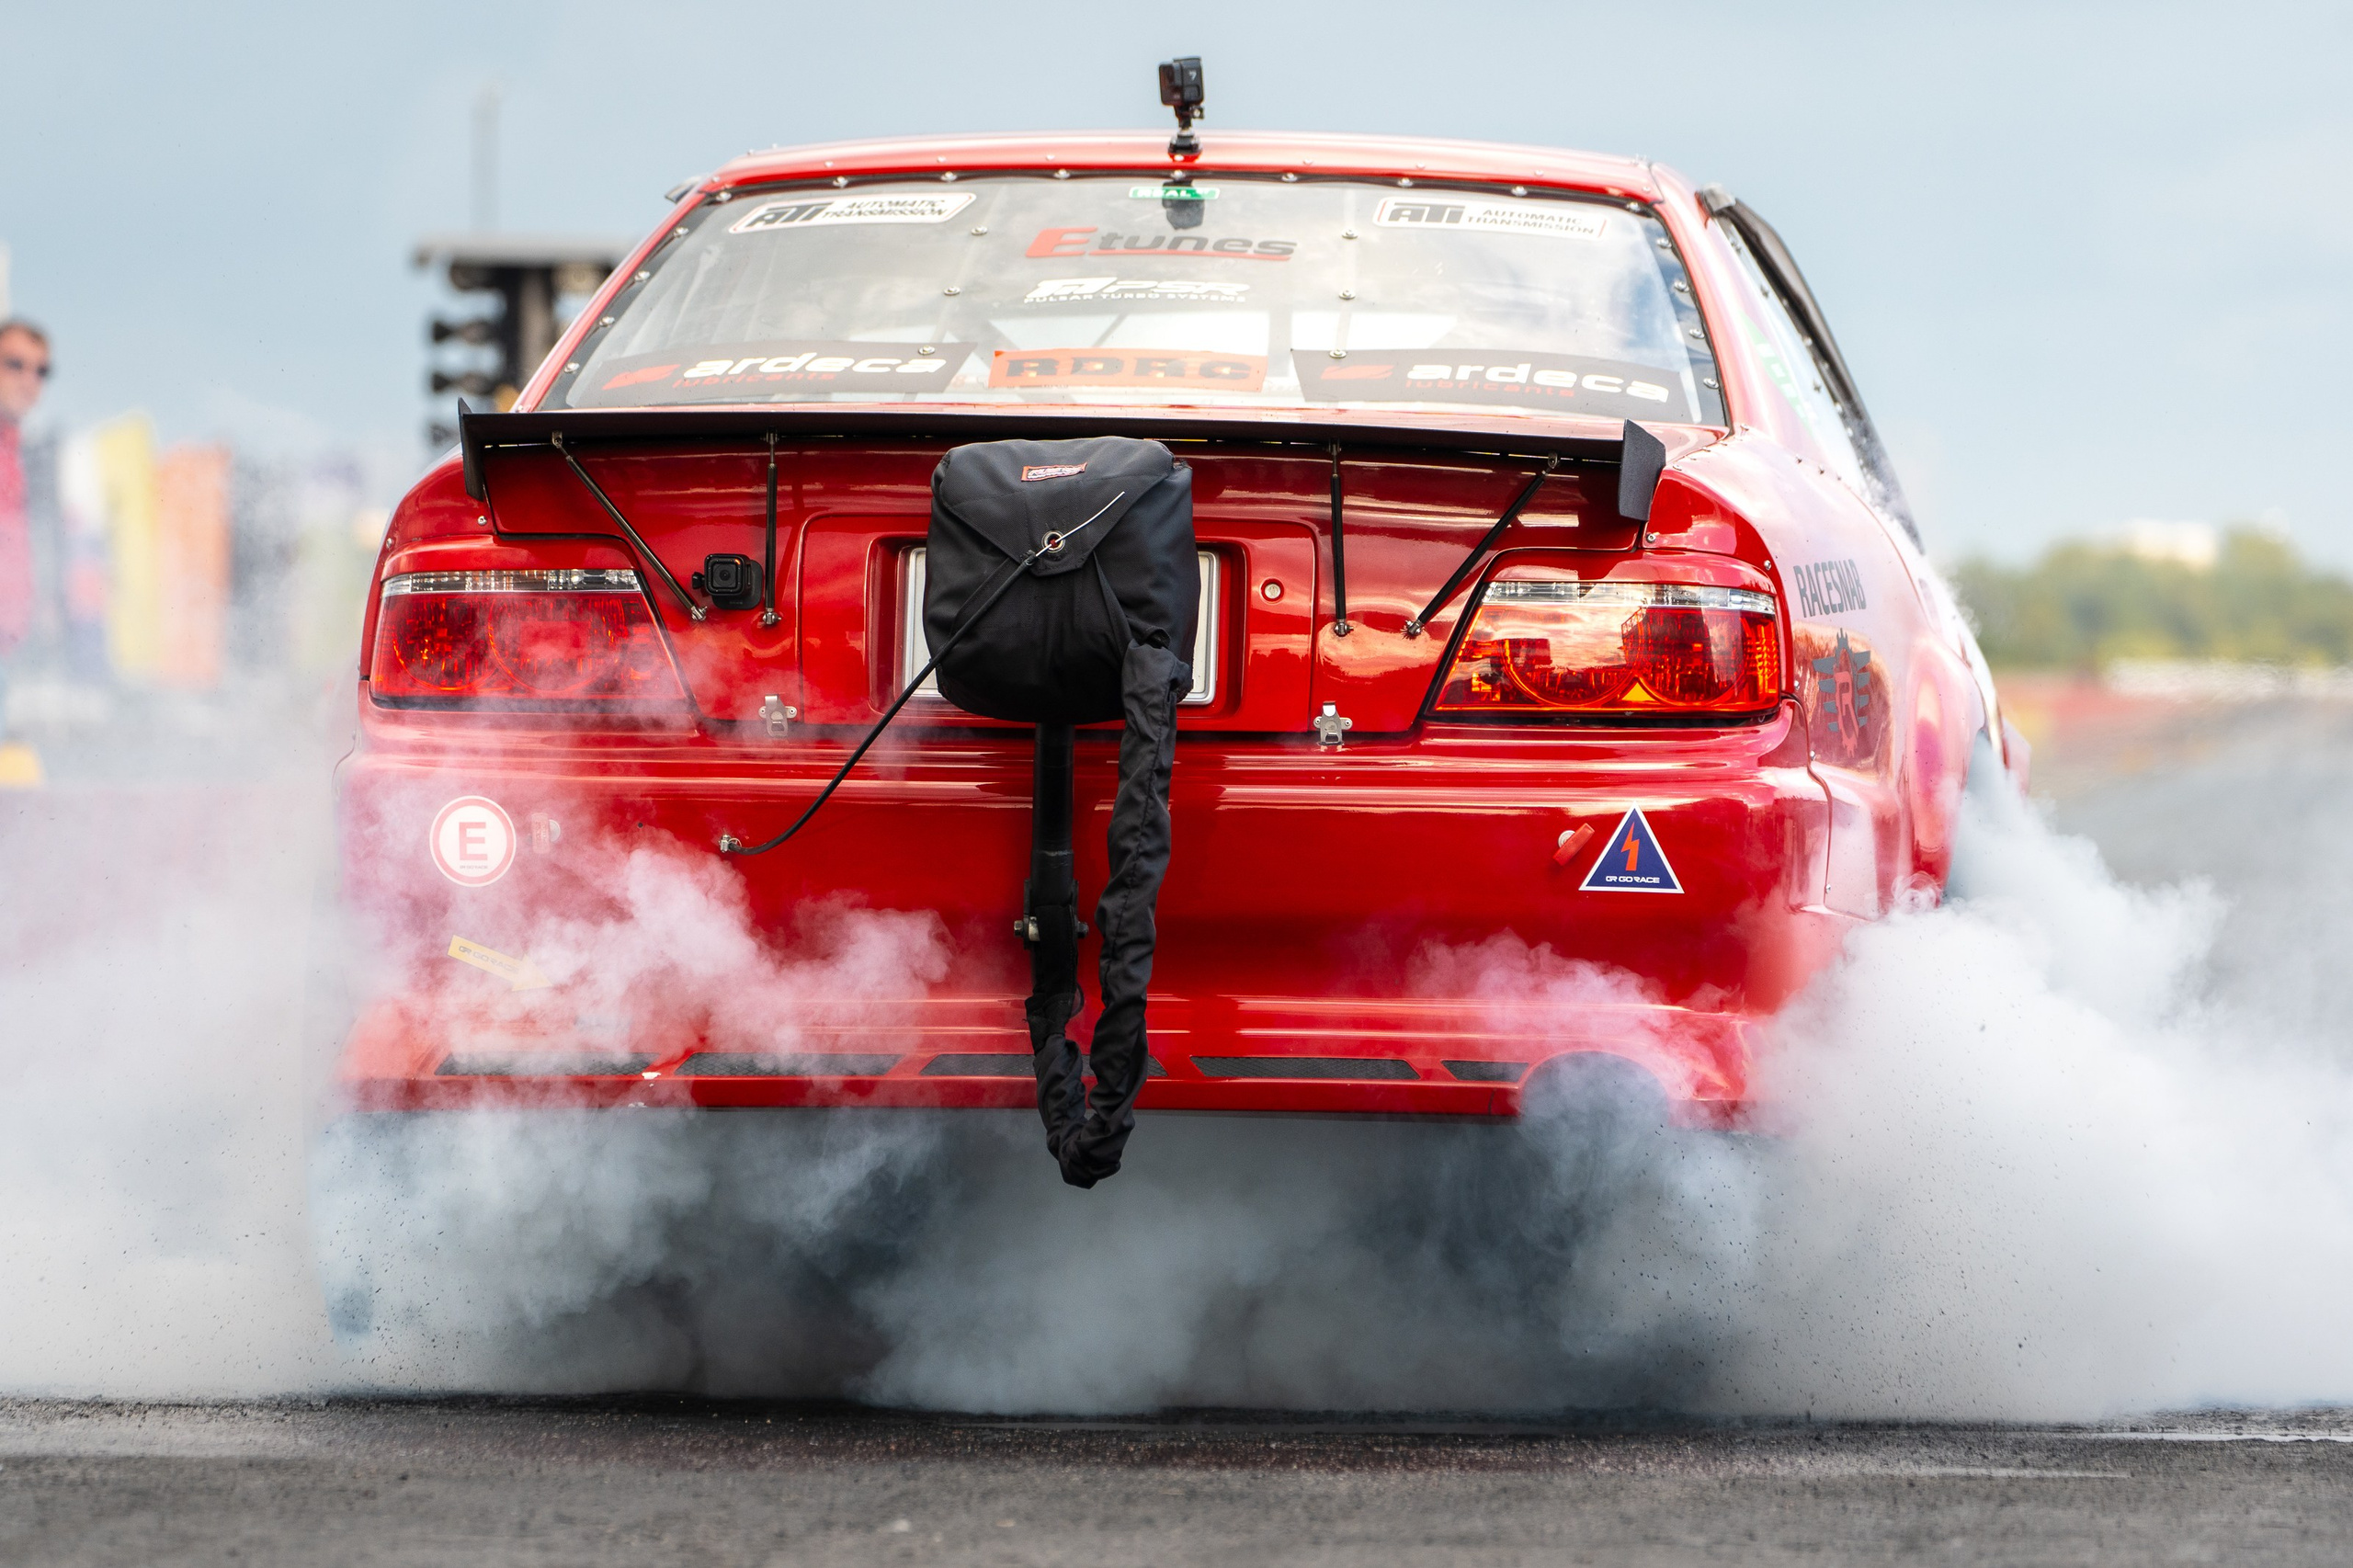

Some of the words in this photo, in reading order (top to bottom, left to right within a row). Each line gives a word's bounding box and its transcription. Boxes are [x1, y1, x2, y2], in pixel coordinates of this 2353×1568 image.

[847, 199, 945, 209] AUTOMATIC
[823, 209, 948, 219] TRANSMISSION
[1483, 209, 1583, 225] AUTOMATIC
[1467, 216, 1595, 234] TRANSMISSION
[1025, 227, 1298, 258] Etunes
[1024, 293, 1094, 303] PULSAR
[1166, 292, 1246, 302] SYSTEMS
[683, 352, 947, 379] ardeca
[672, 372, 835, 388] lubricants
[1405, 379, 1575, 398] lubricants
[1406, 363, 1670, 403] ardeca
[1793, 558, 1867, 619] RACESNAB
[459, 822, 488, 861] E
